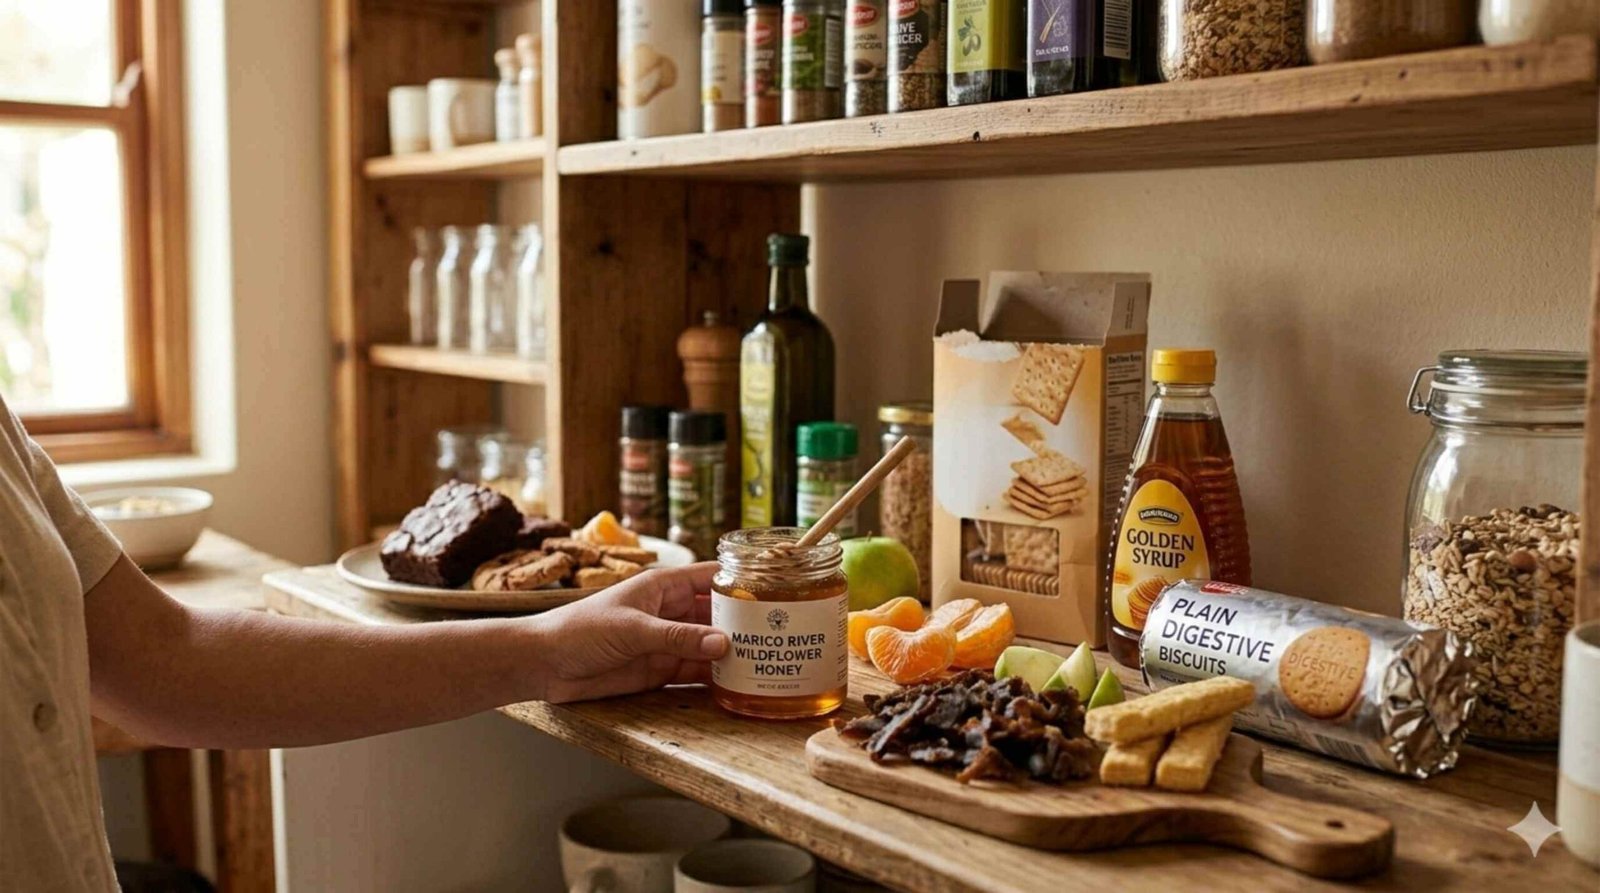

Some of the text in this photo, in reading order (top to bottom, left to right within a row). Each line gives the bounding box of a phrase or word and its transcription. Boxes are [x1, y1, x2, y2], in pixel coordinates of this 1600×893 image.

[1126, 528, 1195, 551] GOLDEN
[1132, 548, 1186, 569] SYRUP
[1170, 598, 1238, 626] PLAIN
[732, 632, 825, 647] MARICO RIVER
[1161, 619, 1275, 663] DIGESTIVE
[735, 647, 822, 661] WILDFLOWER
[1159, 646, 1227, 676] BISCUITS
[755, 664, 803, 676] HONEY
